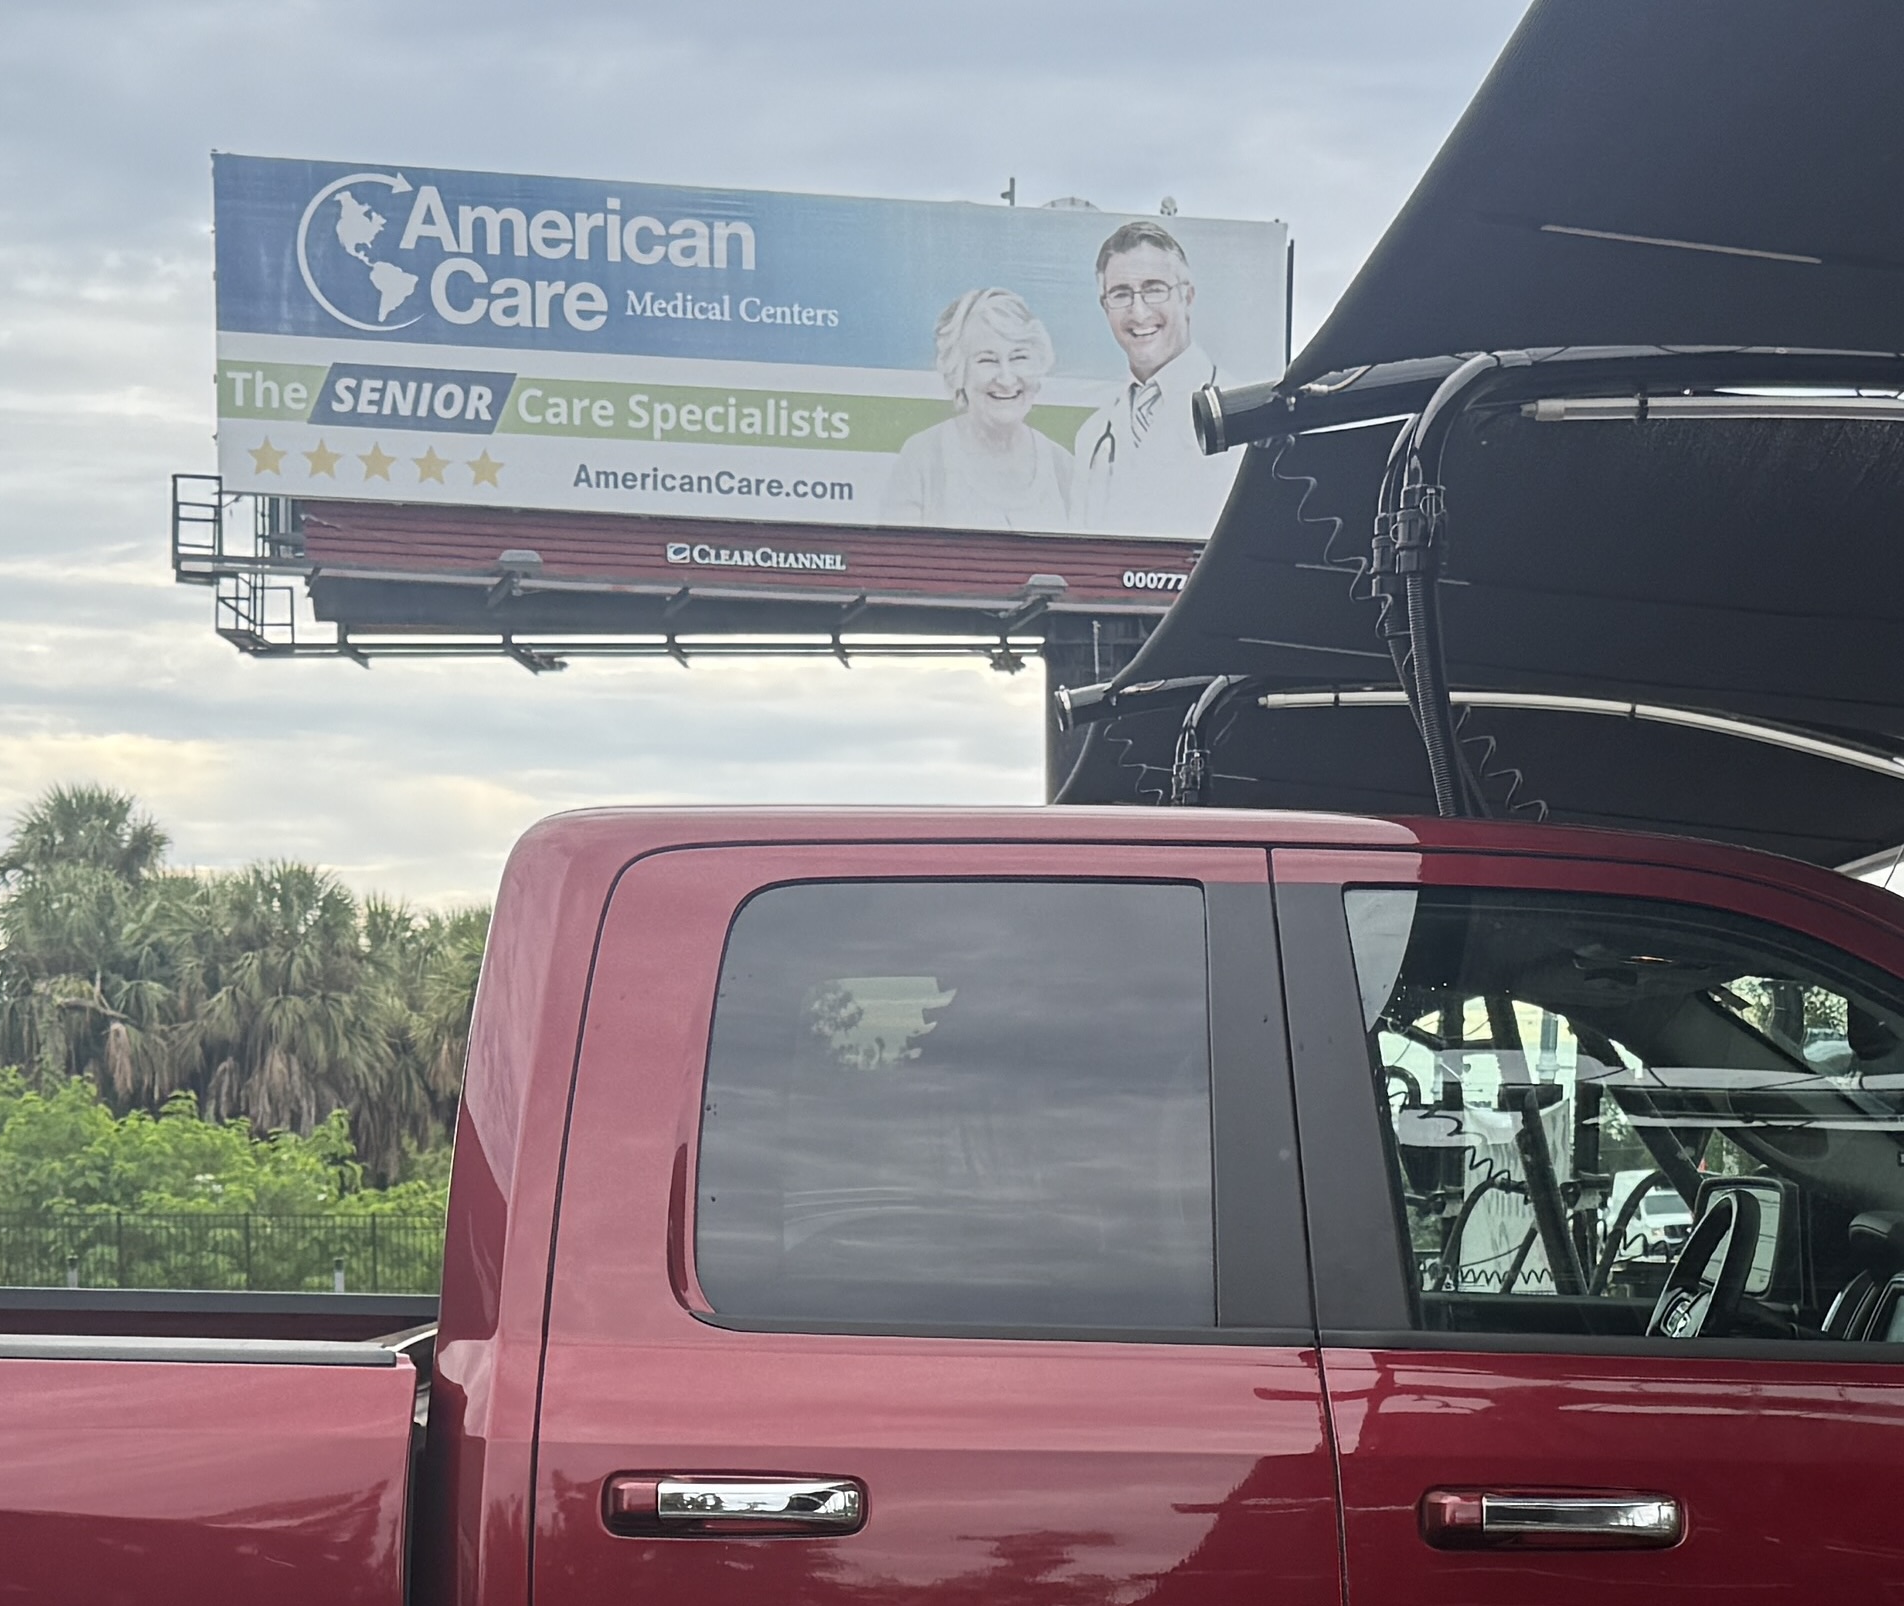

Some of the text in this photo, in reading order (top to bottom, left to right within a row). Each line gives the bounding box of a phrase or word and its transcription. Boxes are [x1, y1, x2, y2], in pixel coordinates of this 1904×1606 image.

[399, 185, 756, 271] American
[429, 257, 609, 332] Care
[624, 289, 840, 328] Medical Centers
[226, 370, 851, 441] The SENIOR Care Specialists
[573, 463, 854, 501] AmericanCare.com
